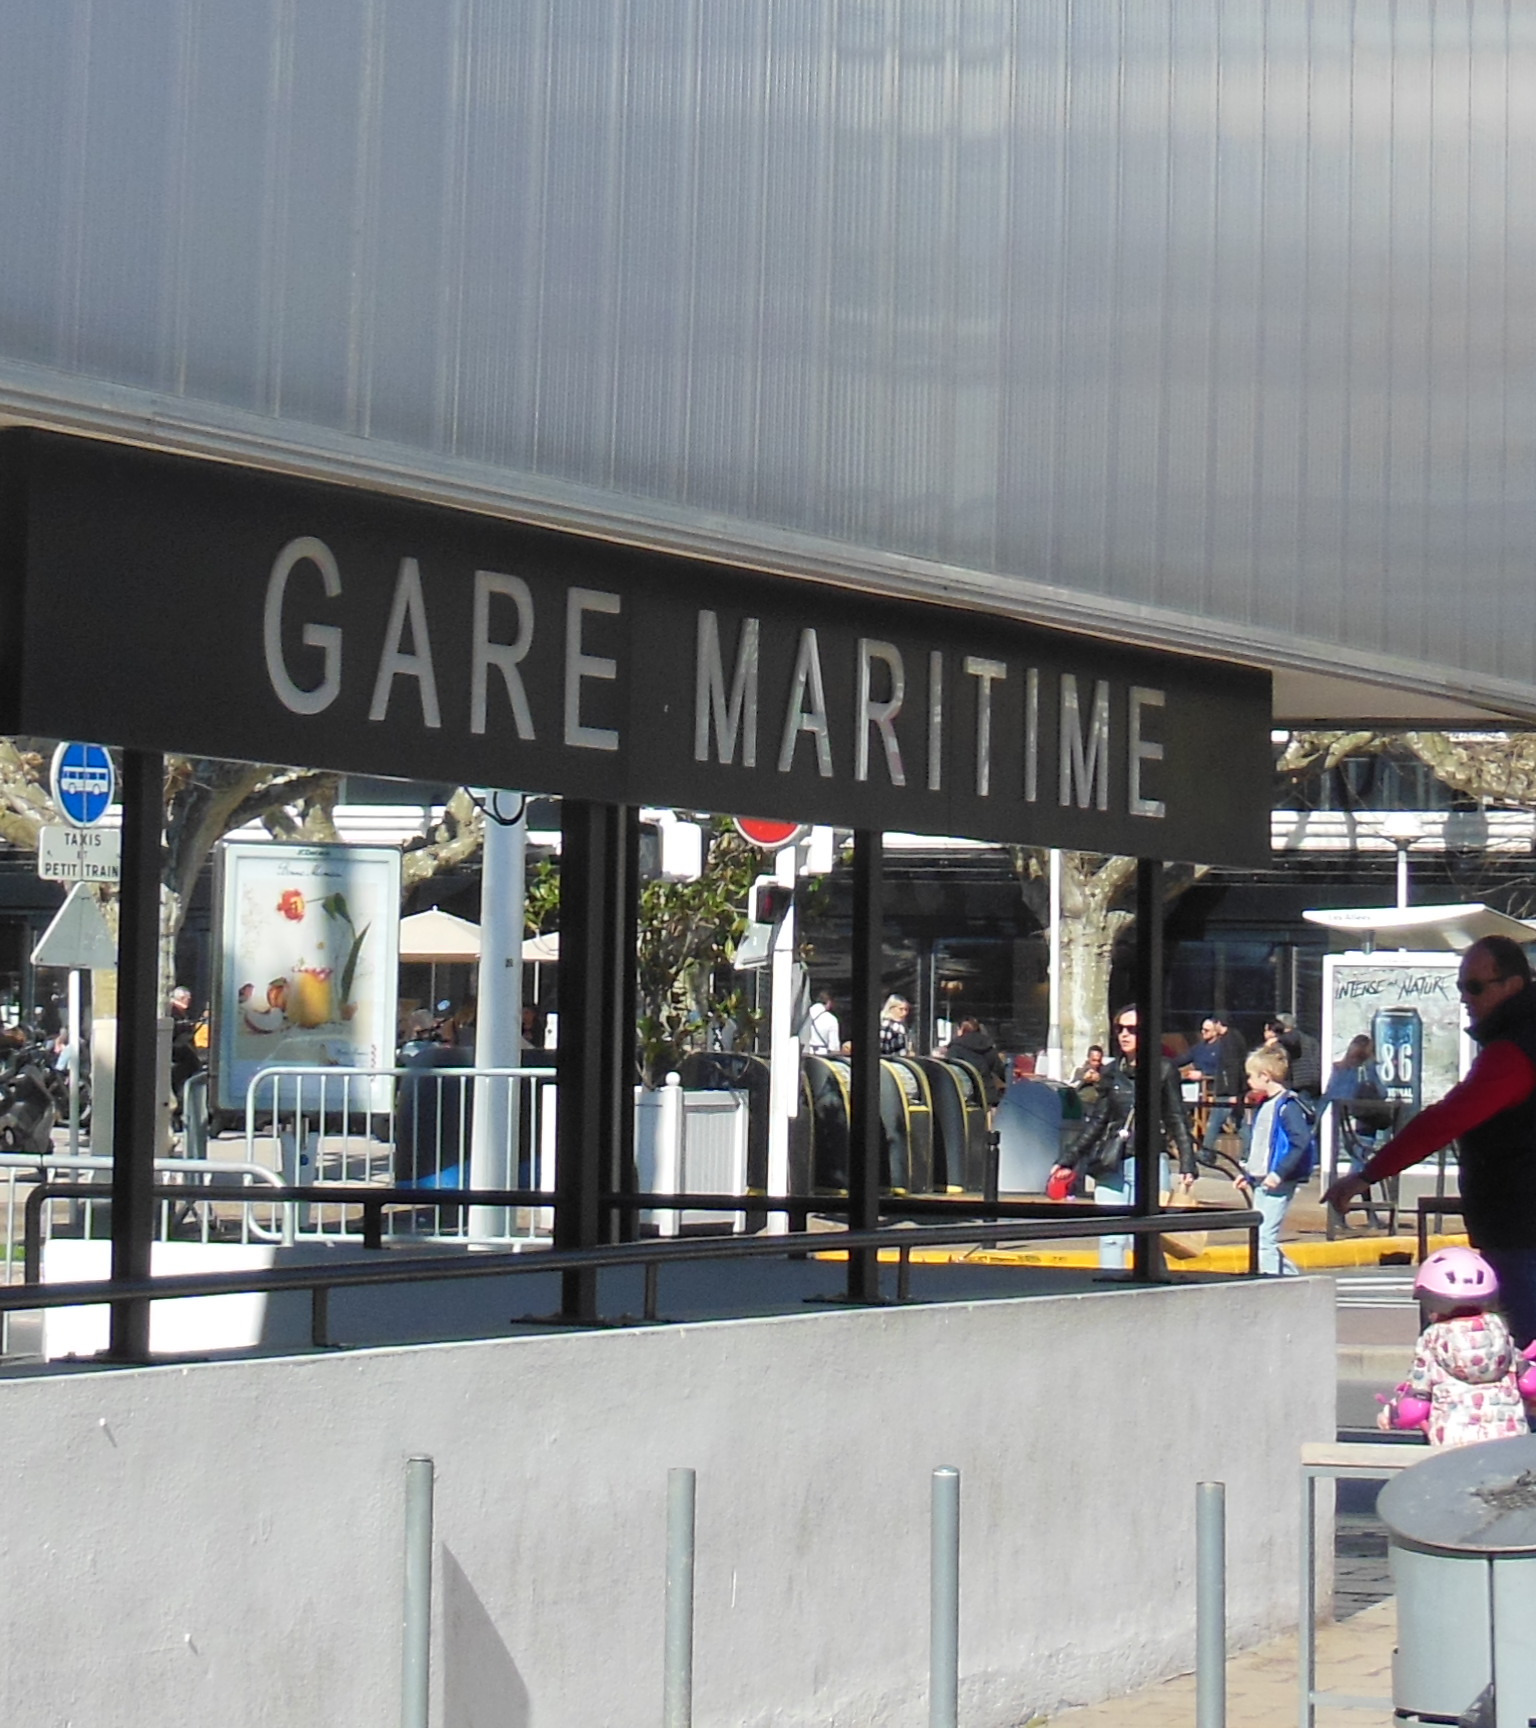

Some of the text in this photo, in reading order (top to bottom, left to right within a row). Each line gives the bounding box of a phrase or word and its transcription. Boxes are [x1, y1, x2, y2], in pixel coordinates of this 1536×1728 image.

[265, 536, 1166, 819] GARE MARITIME
[64, 833, 101, 846] TAXIS
[77, 851, 88, 860] ET
[45, 862, 120, 877] PETIT TRAIN
[1335, 979, 1387, 999] INTENSE
